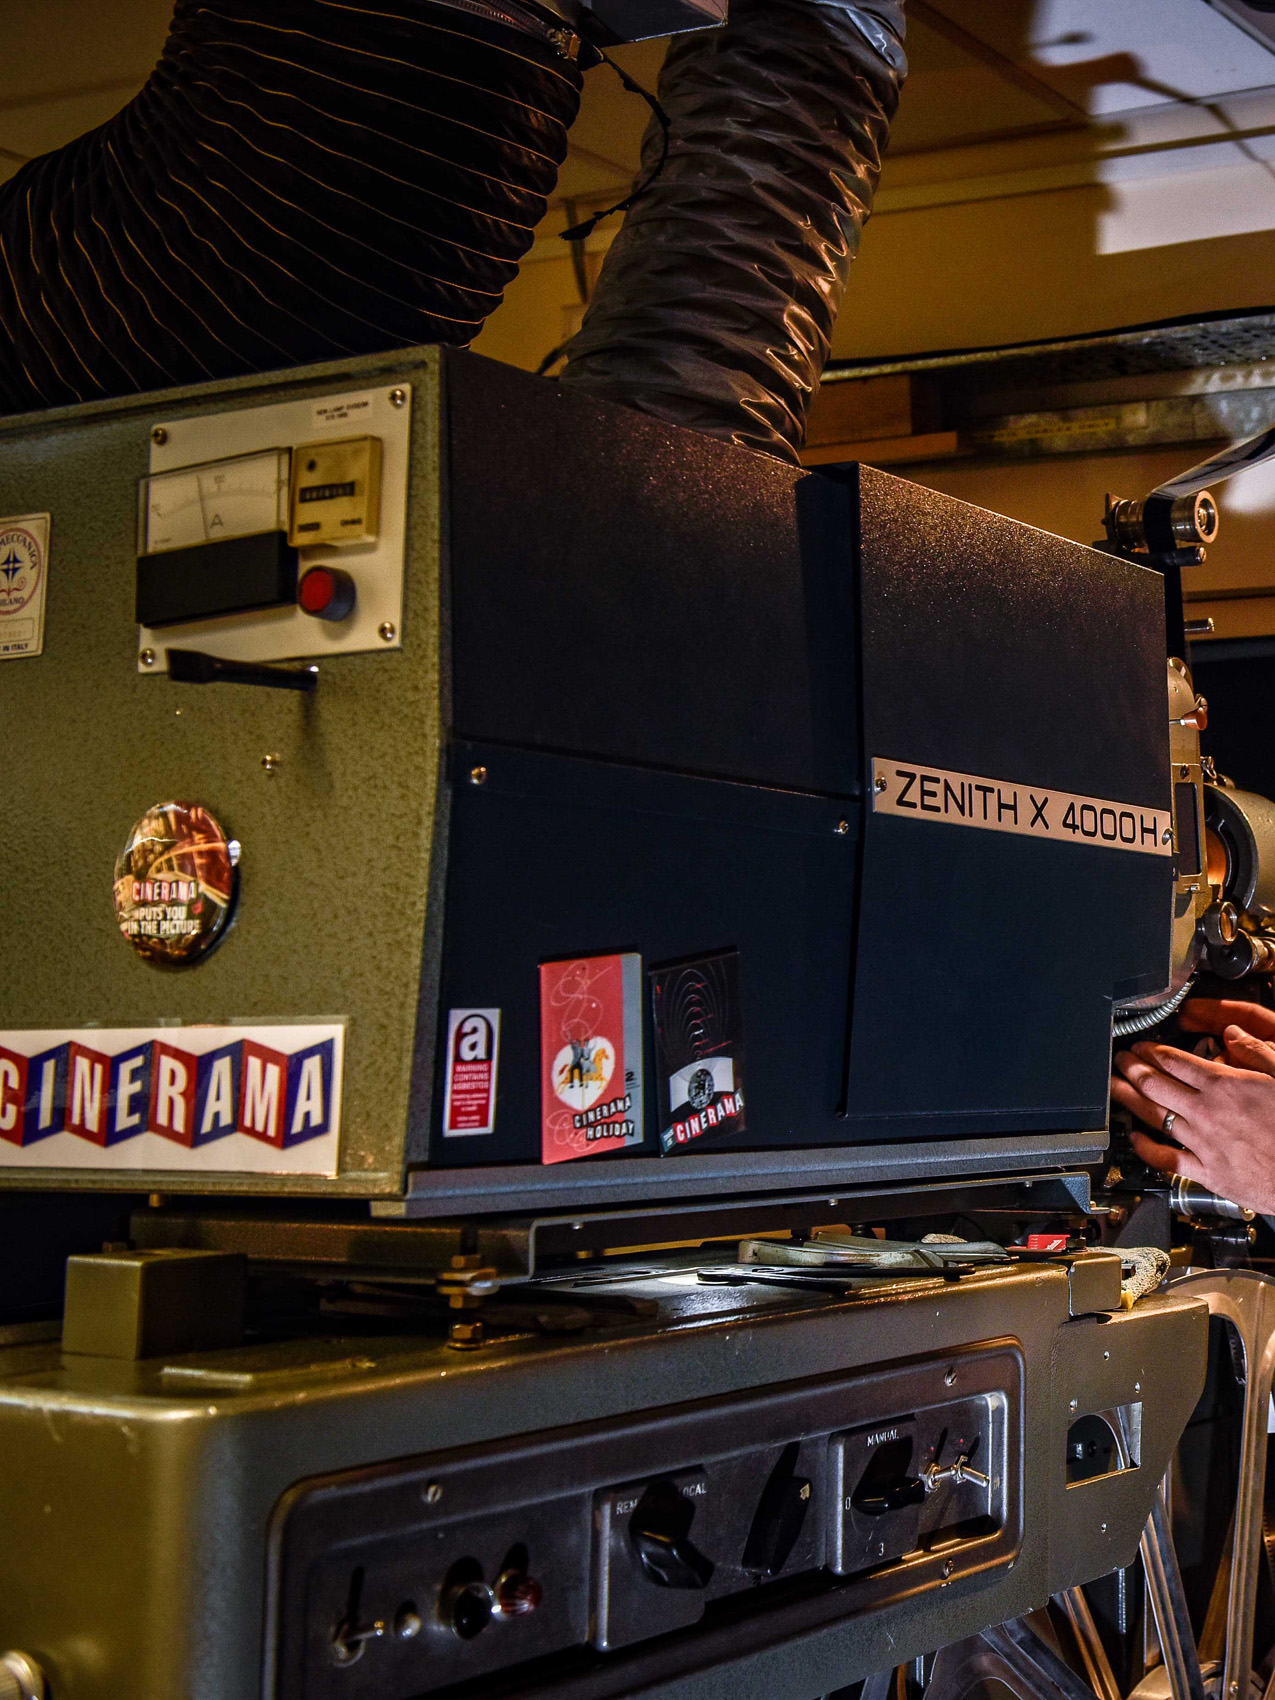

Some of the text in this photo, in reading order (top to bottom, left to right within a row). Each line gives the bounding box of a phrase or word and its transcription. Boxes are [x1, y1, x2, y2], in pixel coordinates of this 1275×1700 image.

[209, 513, 224, 528] A
[895, 770, 1159, 847] ZENITH X 4000H
[132, 881, 196, 902] CINERAMA
[139, 906, 186, 920] PUTS YOU
[128, 919, 201, 934] IN THE PICTURE
[459, 1015, 489, 1061] a
[454, 1072, 489, 1082] CONTAINS
[455, 1063, 489, 1073] WARNING
[625, 1072, 635, 1081] 2
[0, 1053, 324, 1138] CINERAMA
[452, 1081, 489, 1091] ASBESTOS
[574, 1095, 632, 1128] CINERAMA
[676, 1092, 744, 1142] CINERAMA
[586, 1120, 635, 1140] HOLIDAY
[866, 1428, 900, 1447] MANUAL
